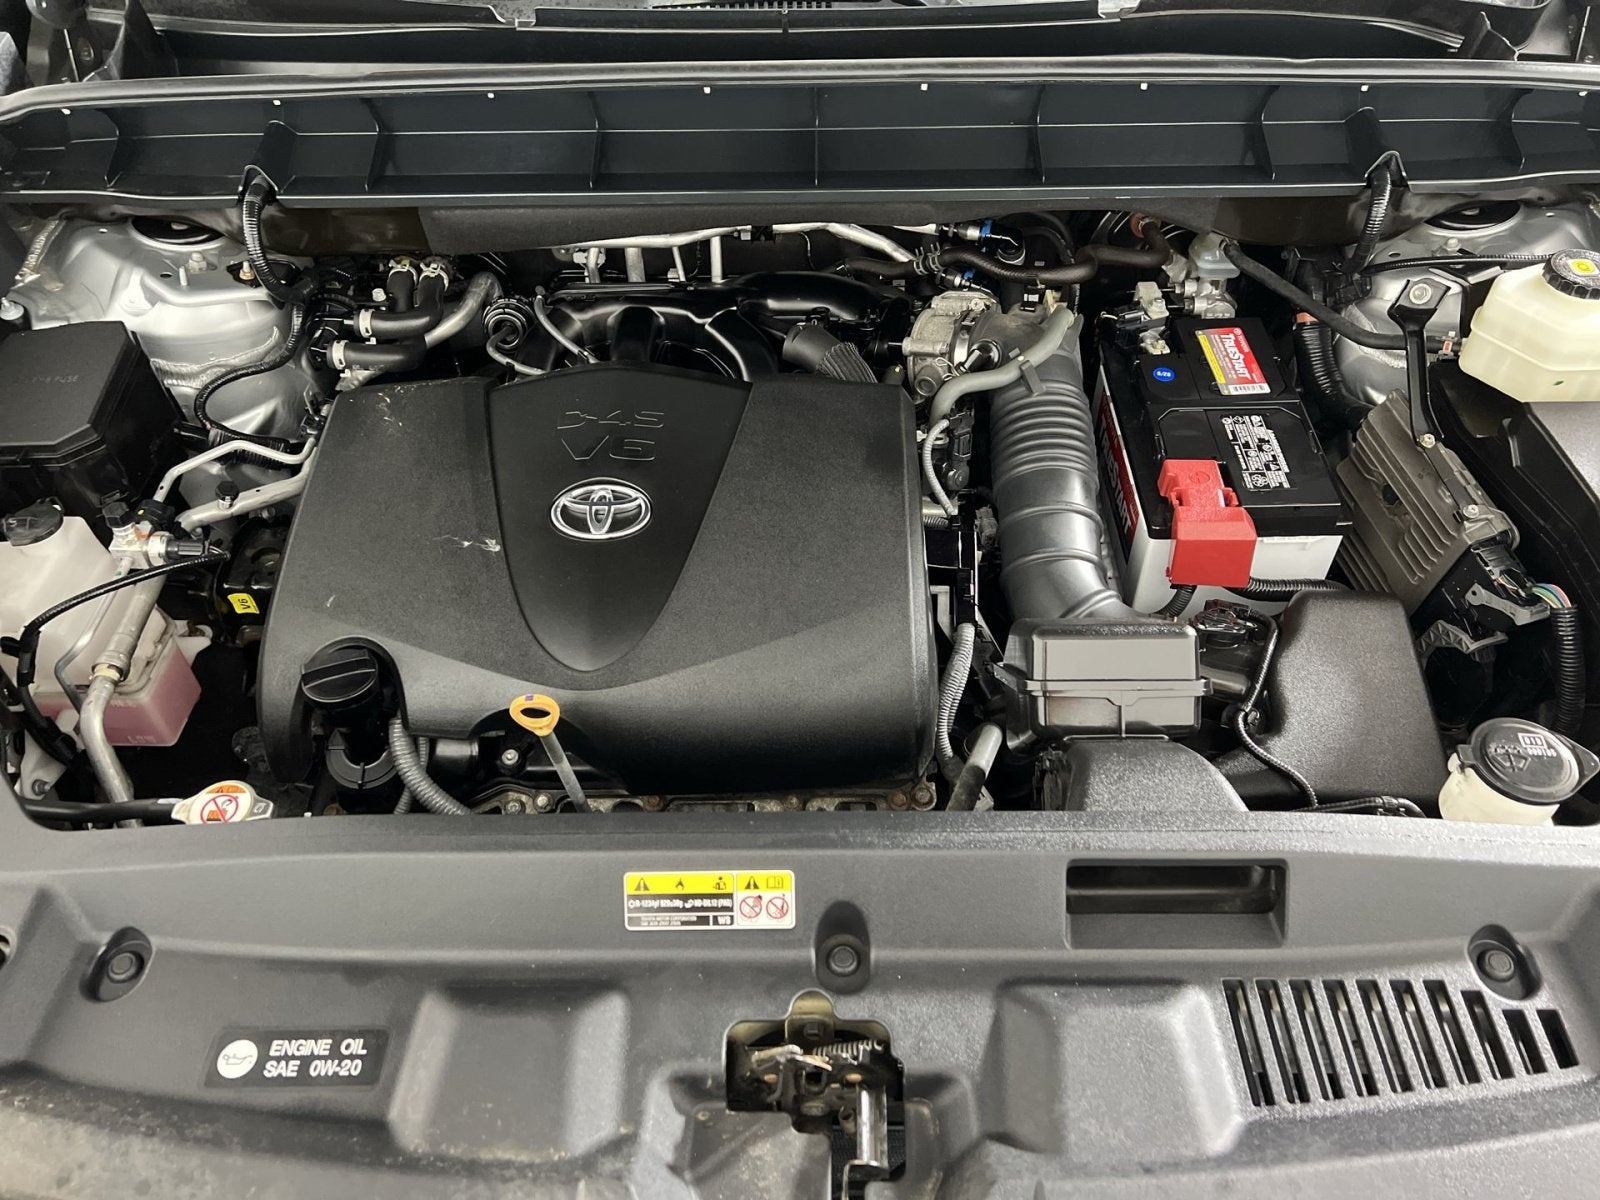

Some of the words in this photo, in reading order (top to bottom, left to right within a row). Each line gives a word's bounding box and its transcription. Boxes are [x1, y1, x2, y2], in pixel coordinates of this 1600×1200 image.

[561, 434, 656, 461] V6
[269, 1039, 332, 1056] ENGINE
[340, 1039, 368, 1055] OIL
[263, 1060, 300, 1077] SAE
[309, 1059, 362, 1077] 0W-20
